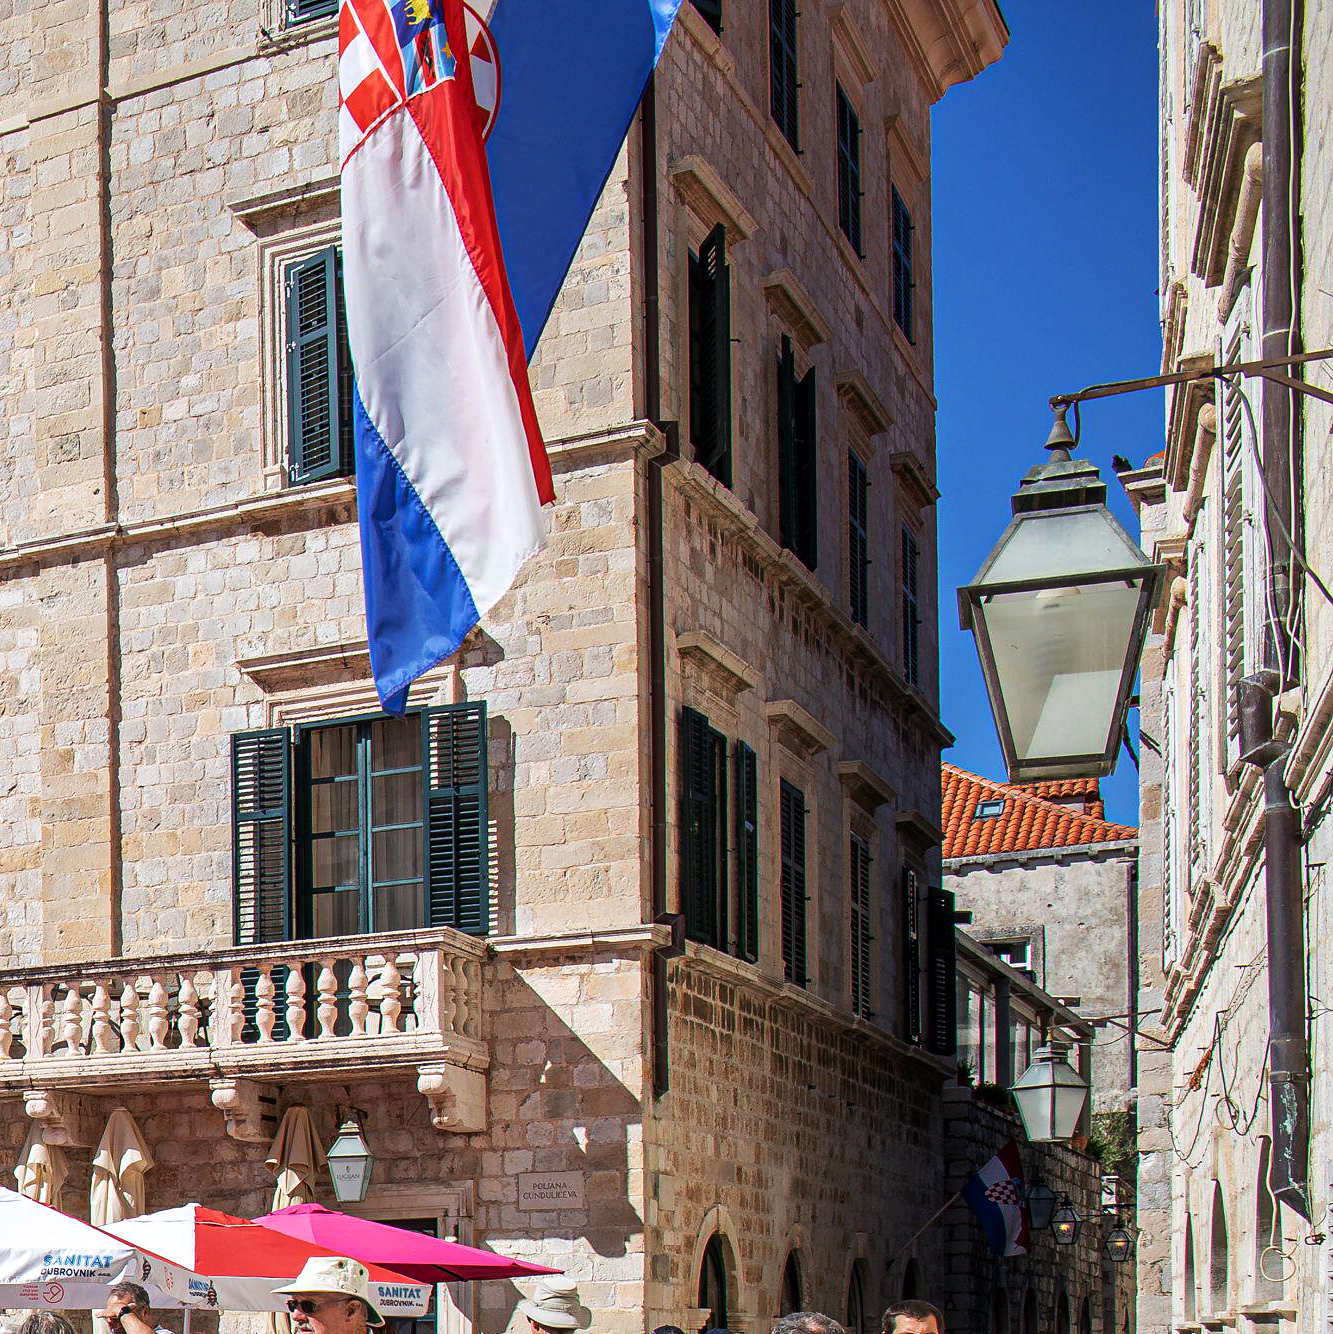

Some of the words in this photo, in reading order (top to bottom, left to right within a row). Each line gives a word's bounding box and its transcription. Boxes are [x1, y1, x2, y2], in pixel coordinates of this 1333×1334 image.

[533, 1182, 568, 1190] POLJANA
[43, 1254, 114, 1268] SANITAT
[41, 1267, 96, 1278] DUBROVNIK
[378, 1287, 421, 1299] SANITAT
[380, 1299, 414, 1307] DUBROVNIK
